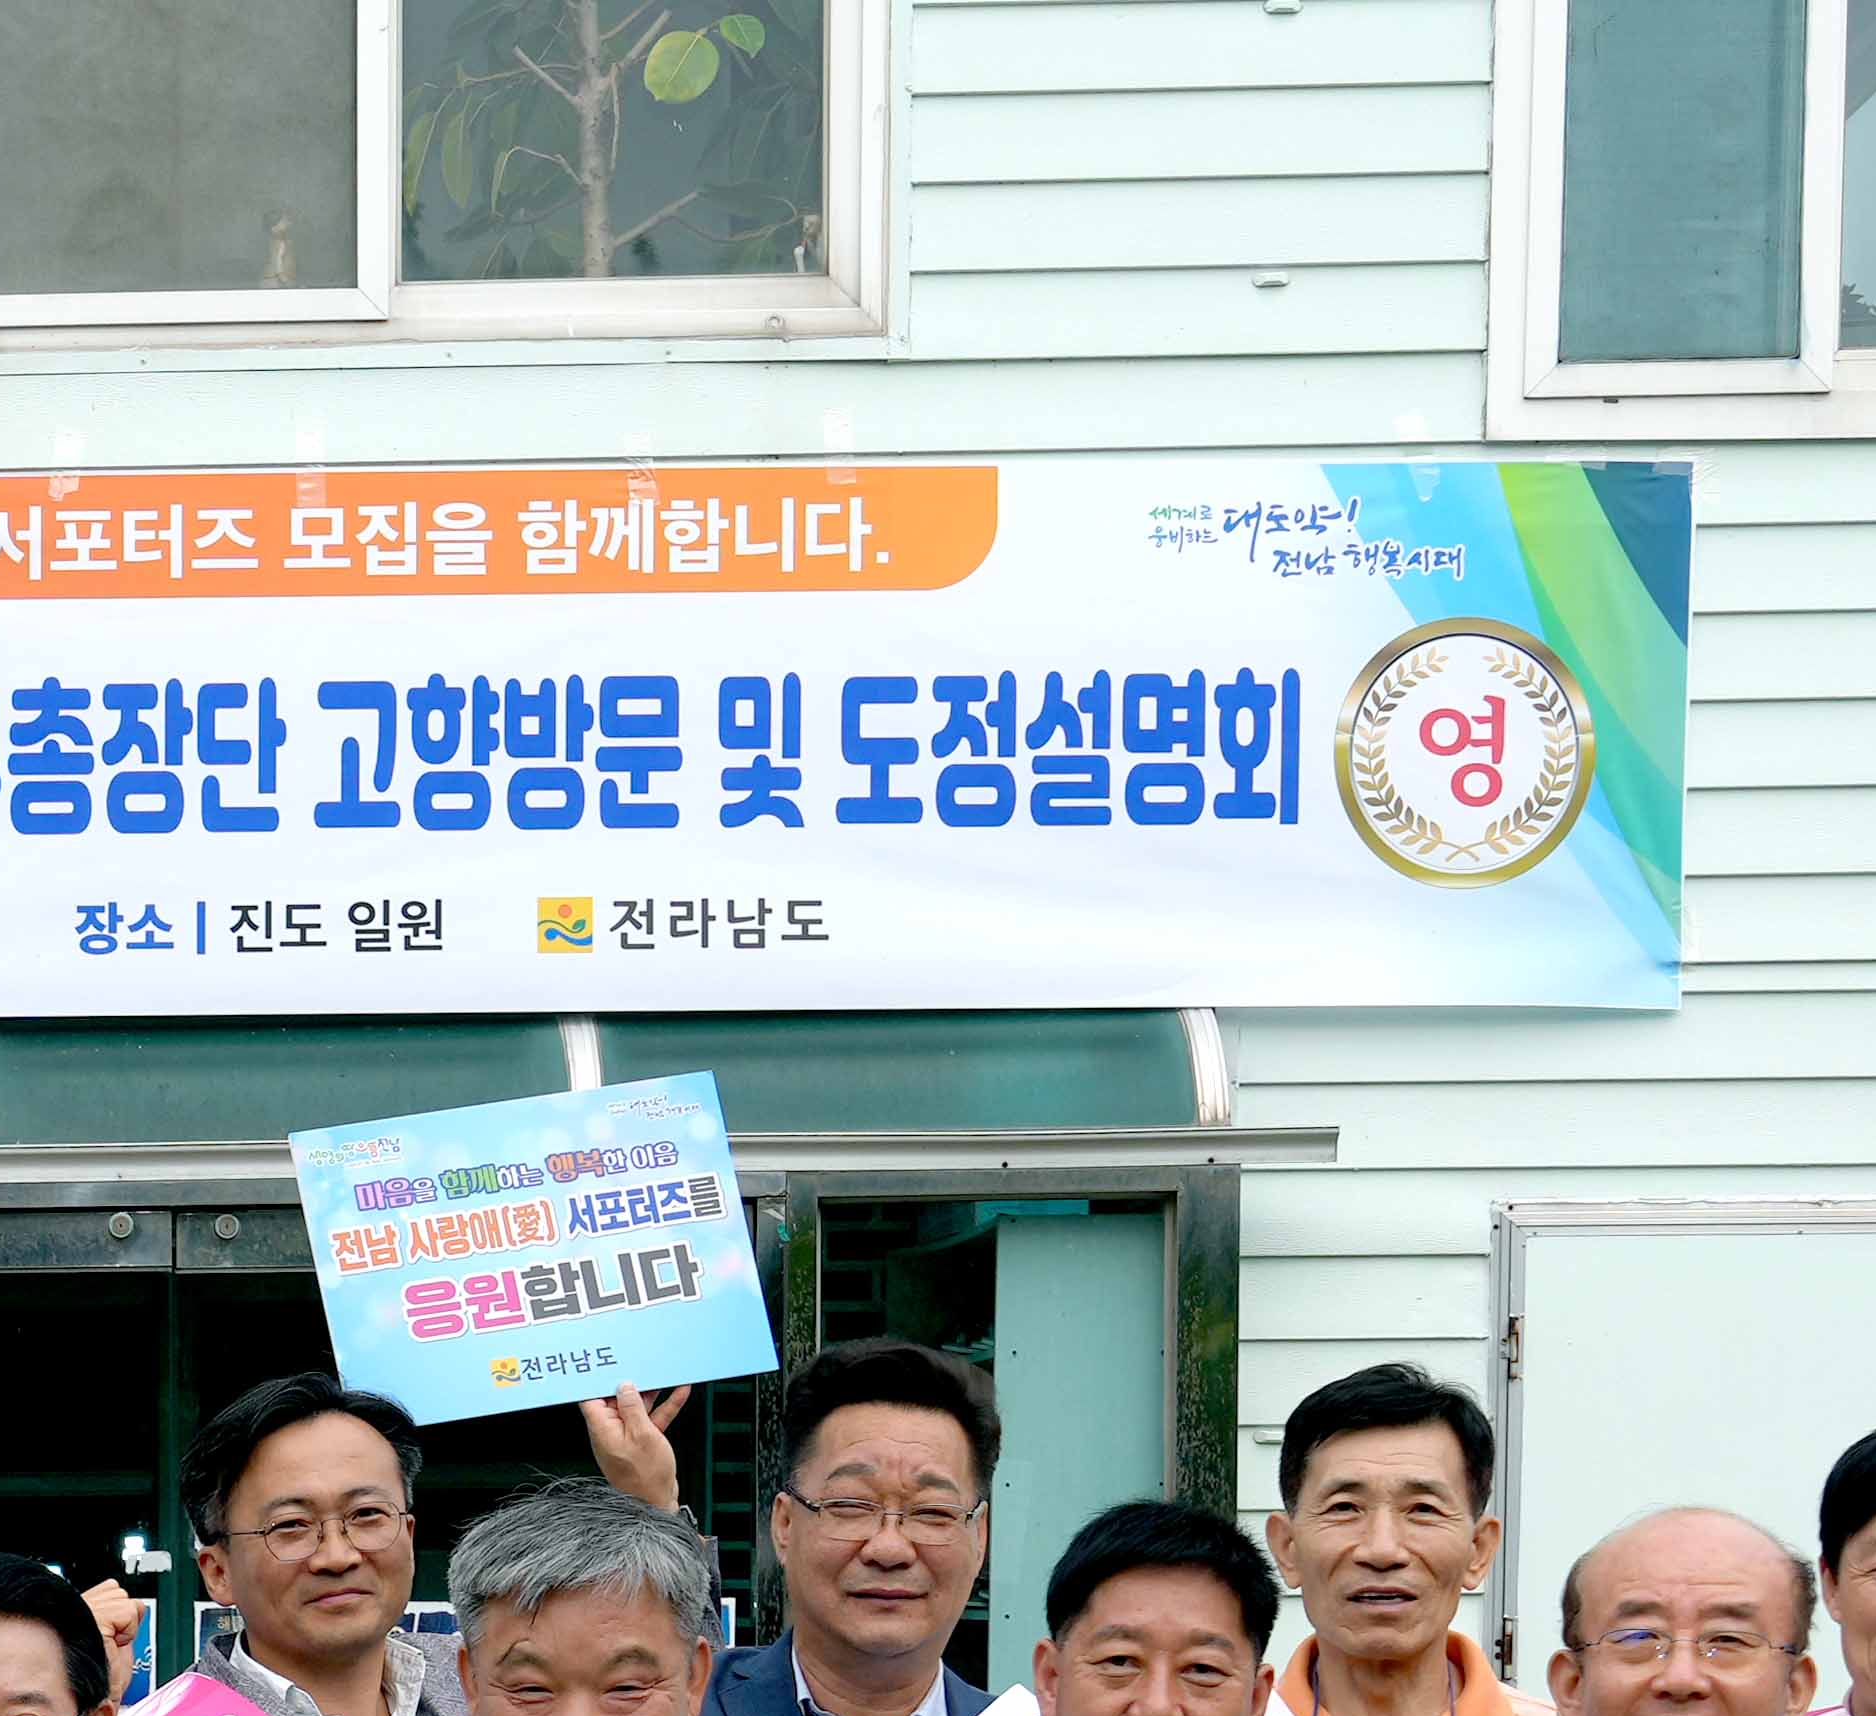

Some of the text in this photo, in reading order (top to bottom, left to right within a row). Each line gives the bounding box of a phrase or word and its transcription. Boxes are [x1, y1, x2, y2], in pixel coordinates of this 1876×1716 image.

[282, 502, 492, 577] 모집을
[520, 495, 891, 575] 함께합니다.
[1273, 547, 1336, 577] 전남
[314, 672, 683, 830] 고향방문
[717, 670, 804, 830] 및
[835, 665, 1301, 827] 도정설명회
[1417, 695, 1504, 808] 영
[75, 901, 172, 955] 장소
[227, 897, 327, 955] 진도
[345, 899, 446, 955] 일원
[608, 897, 831, 950] 전라남도
[354, 1175, 437, 1211] 마음을
[439, 1161, 545, 1197] 함께하는
[545, 1149, 628, 1181] 행복한
[632, 1141, 679, 1170] 이음
[332, 1175, 724, 1272] 전남 사랑애(愛) 서포터즈를
[403, 1244, 703, 1339] 응원합니다
[521, 1348, 617, 1380] 전라남도
